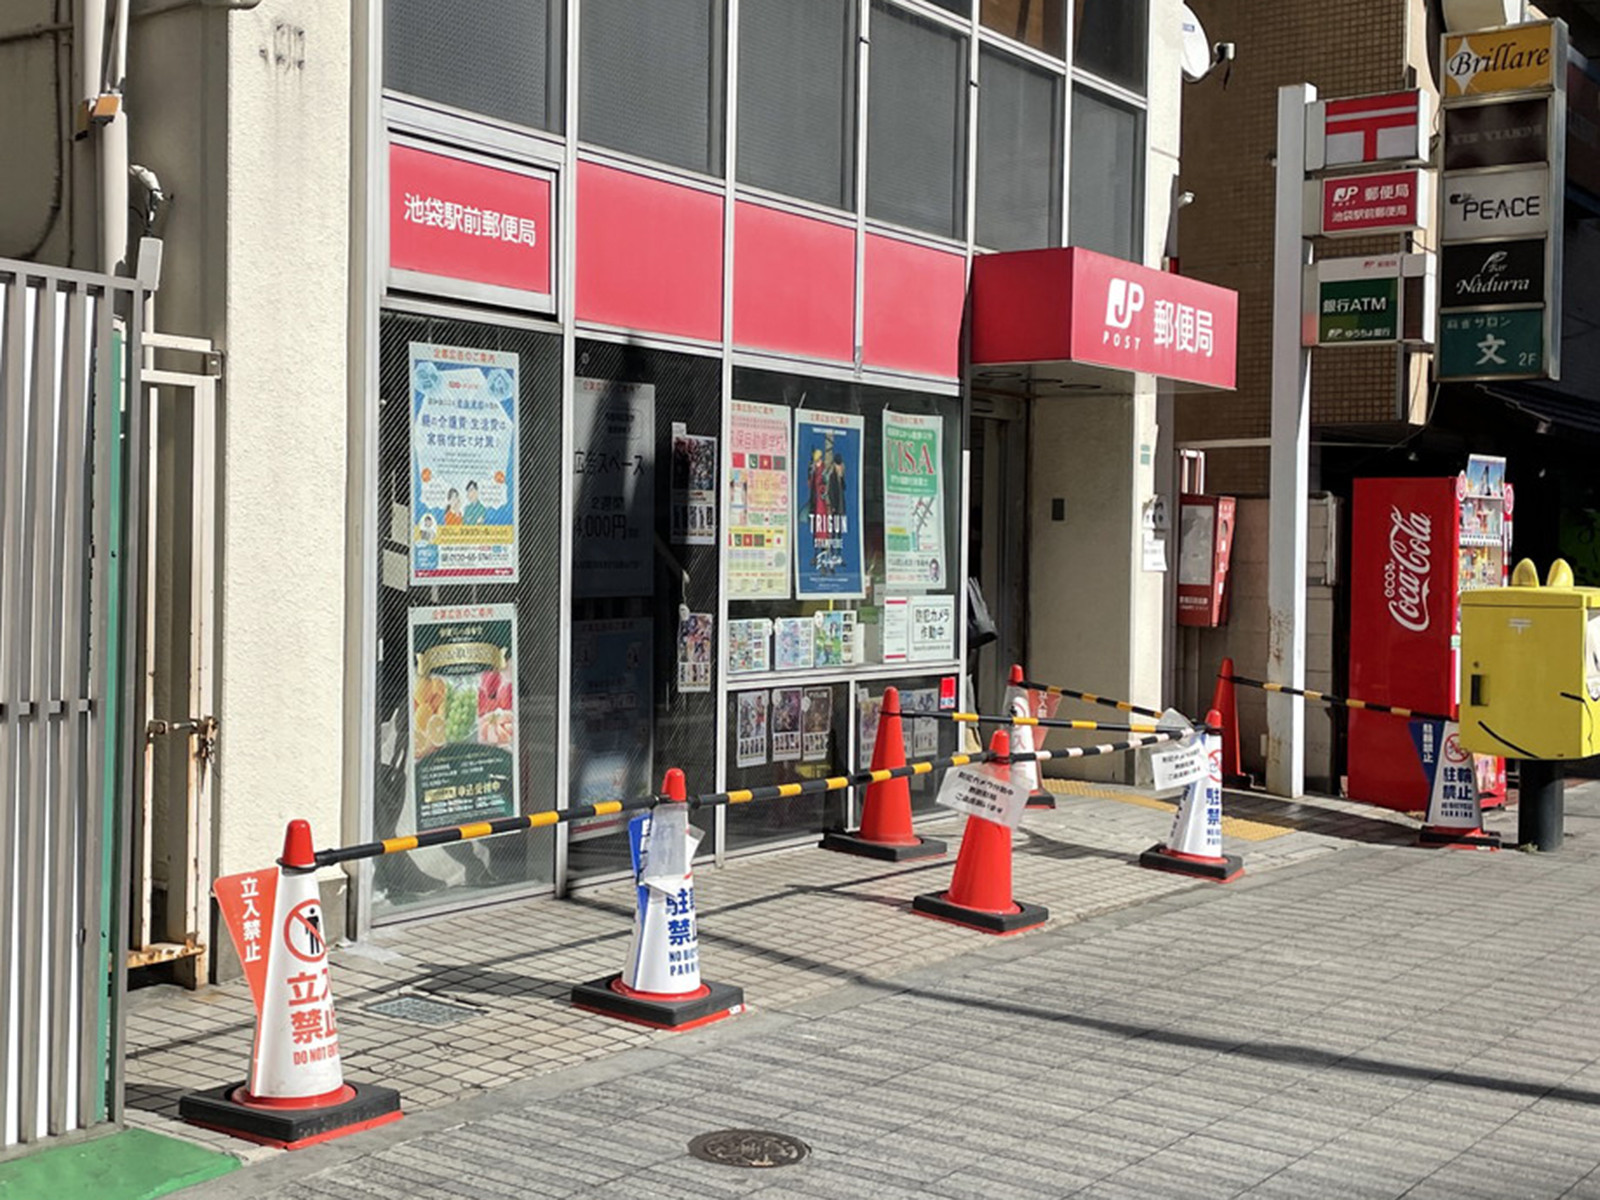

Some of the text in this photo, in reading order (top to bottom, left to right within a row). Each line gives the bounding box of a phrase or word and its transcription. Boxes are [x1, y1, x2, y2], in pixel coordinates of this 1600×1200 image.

[1450, 42, 1550, 76] Brillare
[1365, 184, 1410, 201] 郵便局
[1463, 196, 1540, 221] PEACE
[404, 192, 536, 247] 池袋駅前郵便局
[1323, 297, 1387, 313] 銀行ATM
[1154, 299, 1213, 357] 郵便局
[1103, 330, 1141, 351] POST
[1475, 333, 1508, 365] 文
[1518, 352, 1538, 366] 2F
[809, 514, 848, 534] TRIGUN
[1388, 504, 1432, 632] Coca-Cola
[1443, 767, 1472, 783] 駐輪
[1206, 788, 1220, 805] 駐
[1443, 784, 1473, 800] 禁止
[665, 887, 695, 916] 駐
[240, 877, 262, 963] 立入禁止
[293, 1051, 307, 1065] DO
[309, 1047, 326, 1062] NOT
